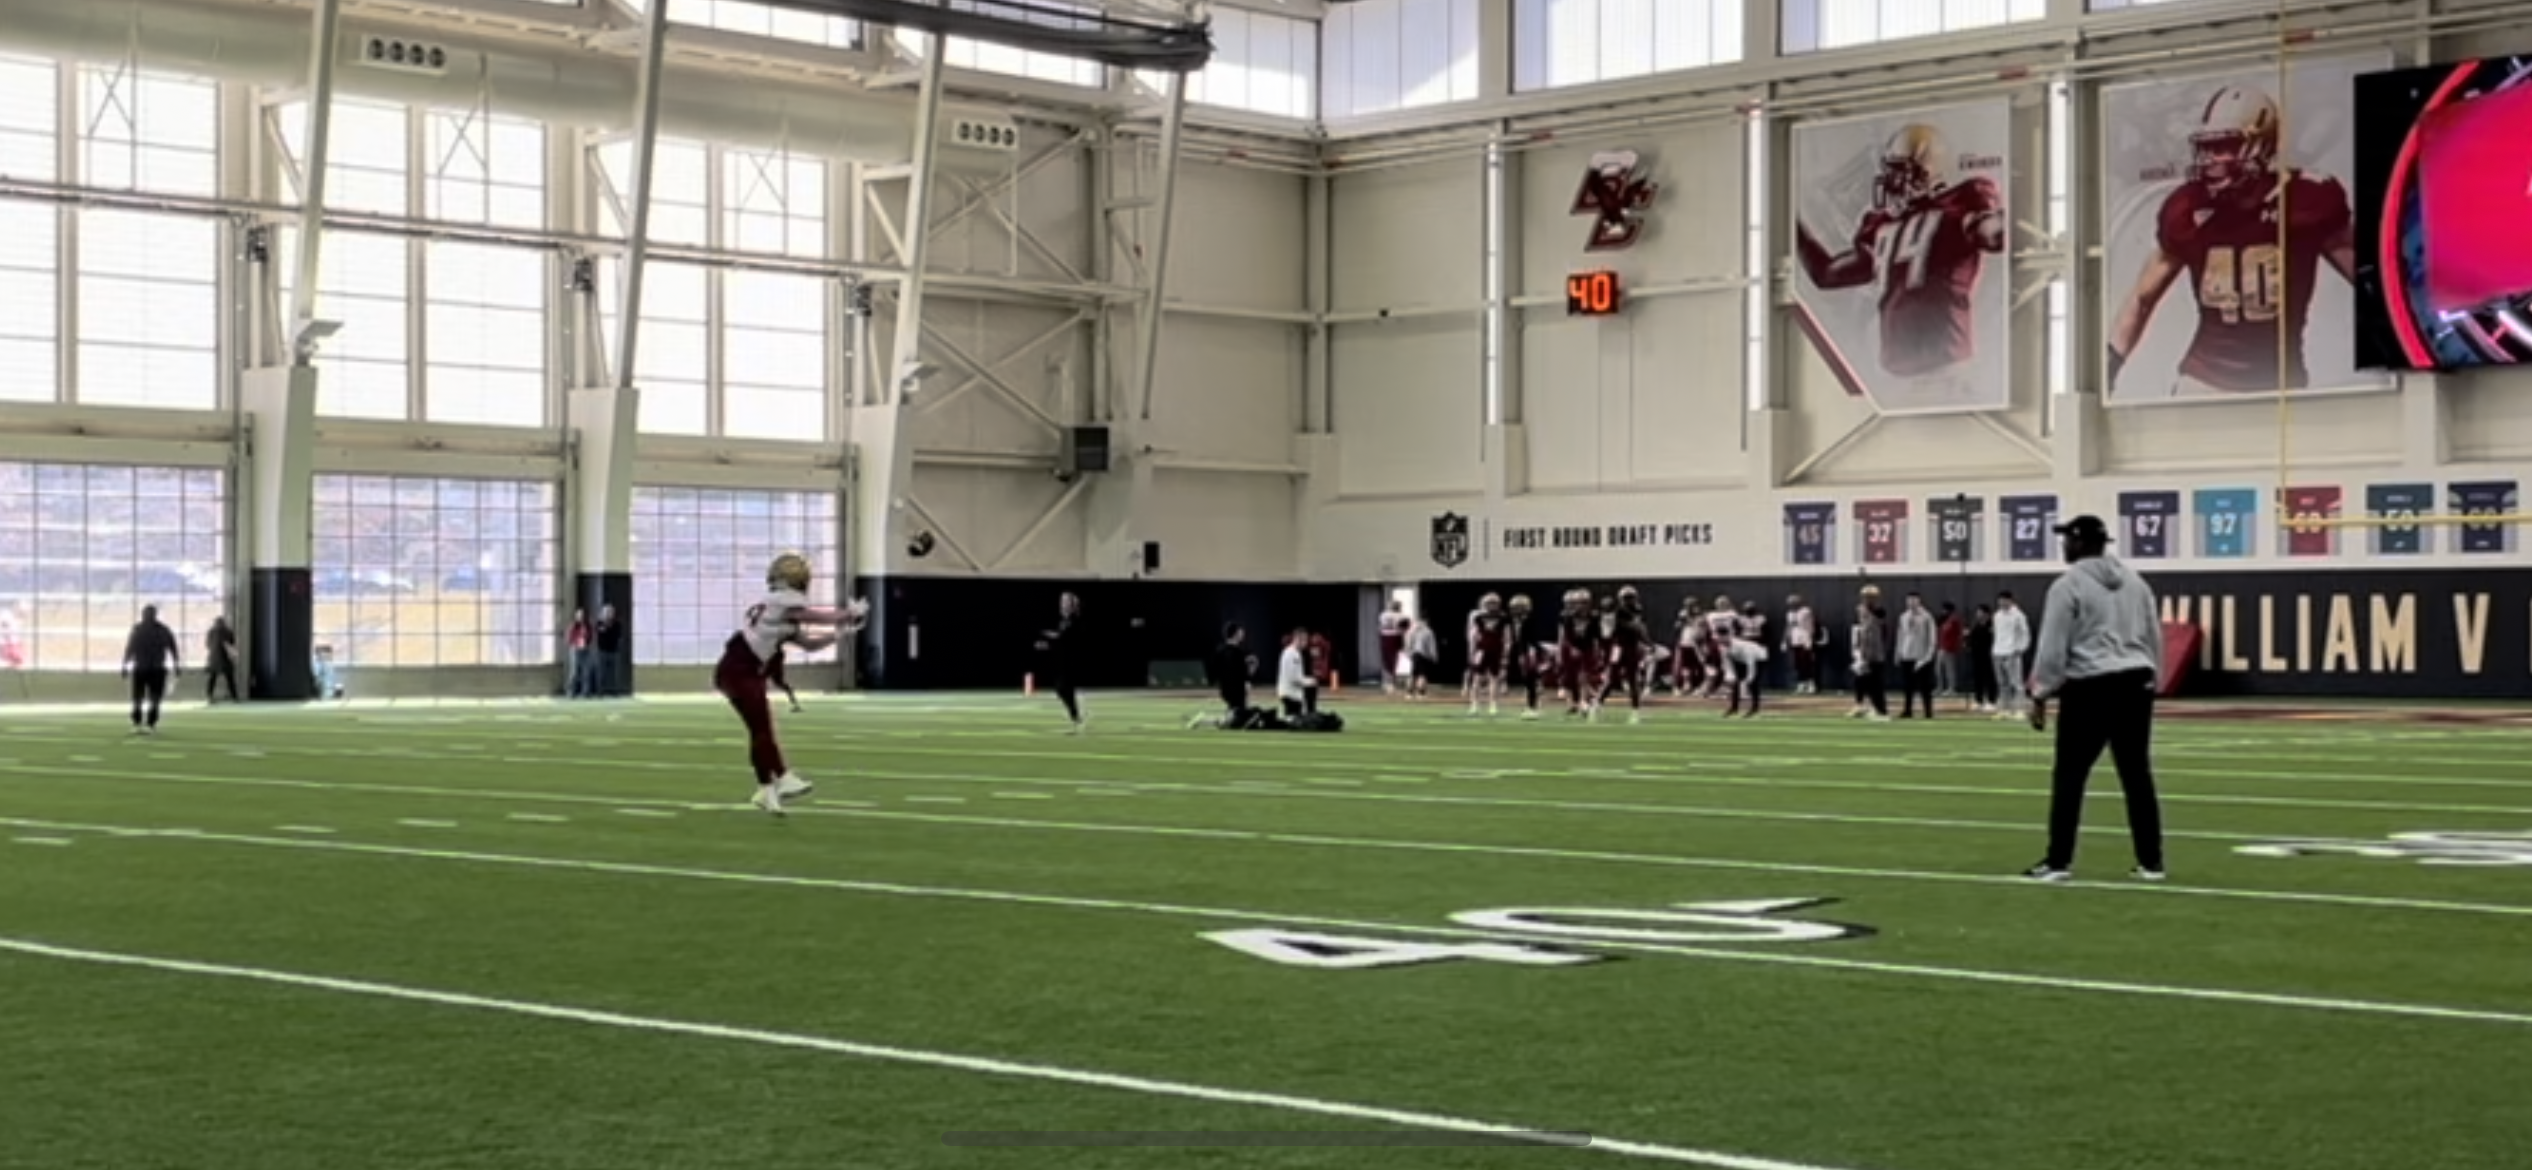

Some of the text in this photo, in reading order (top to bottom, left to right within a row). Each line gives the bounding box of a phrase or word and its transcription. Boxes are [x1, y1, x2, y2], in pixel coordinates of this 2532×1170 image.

[1873, 211, 1942, 290] 94
[1568, 273, 1611, 311] 40
[2202, 244, 2285, 323] 40
[1503, 523, 1713, 549] FIRST ROUND DRAFT PICKS
[2015, 517, 2041, 541] 27
[2135, 513, 2161, 537] 67
[2209, 511, 2237, 537] 97
[2453, 592, 2491, 674] V
